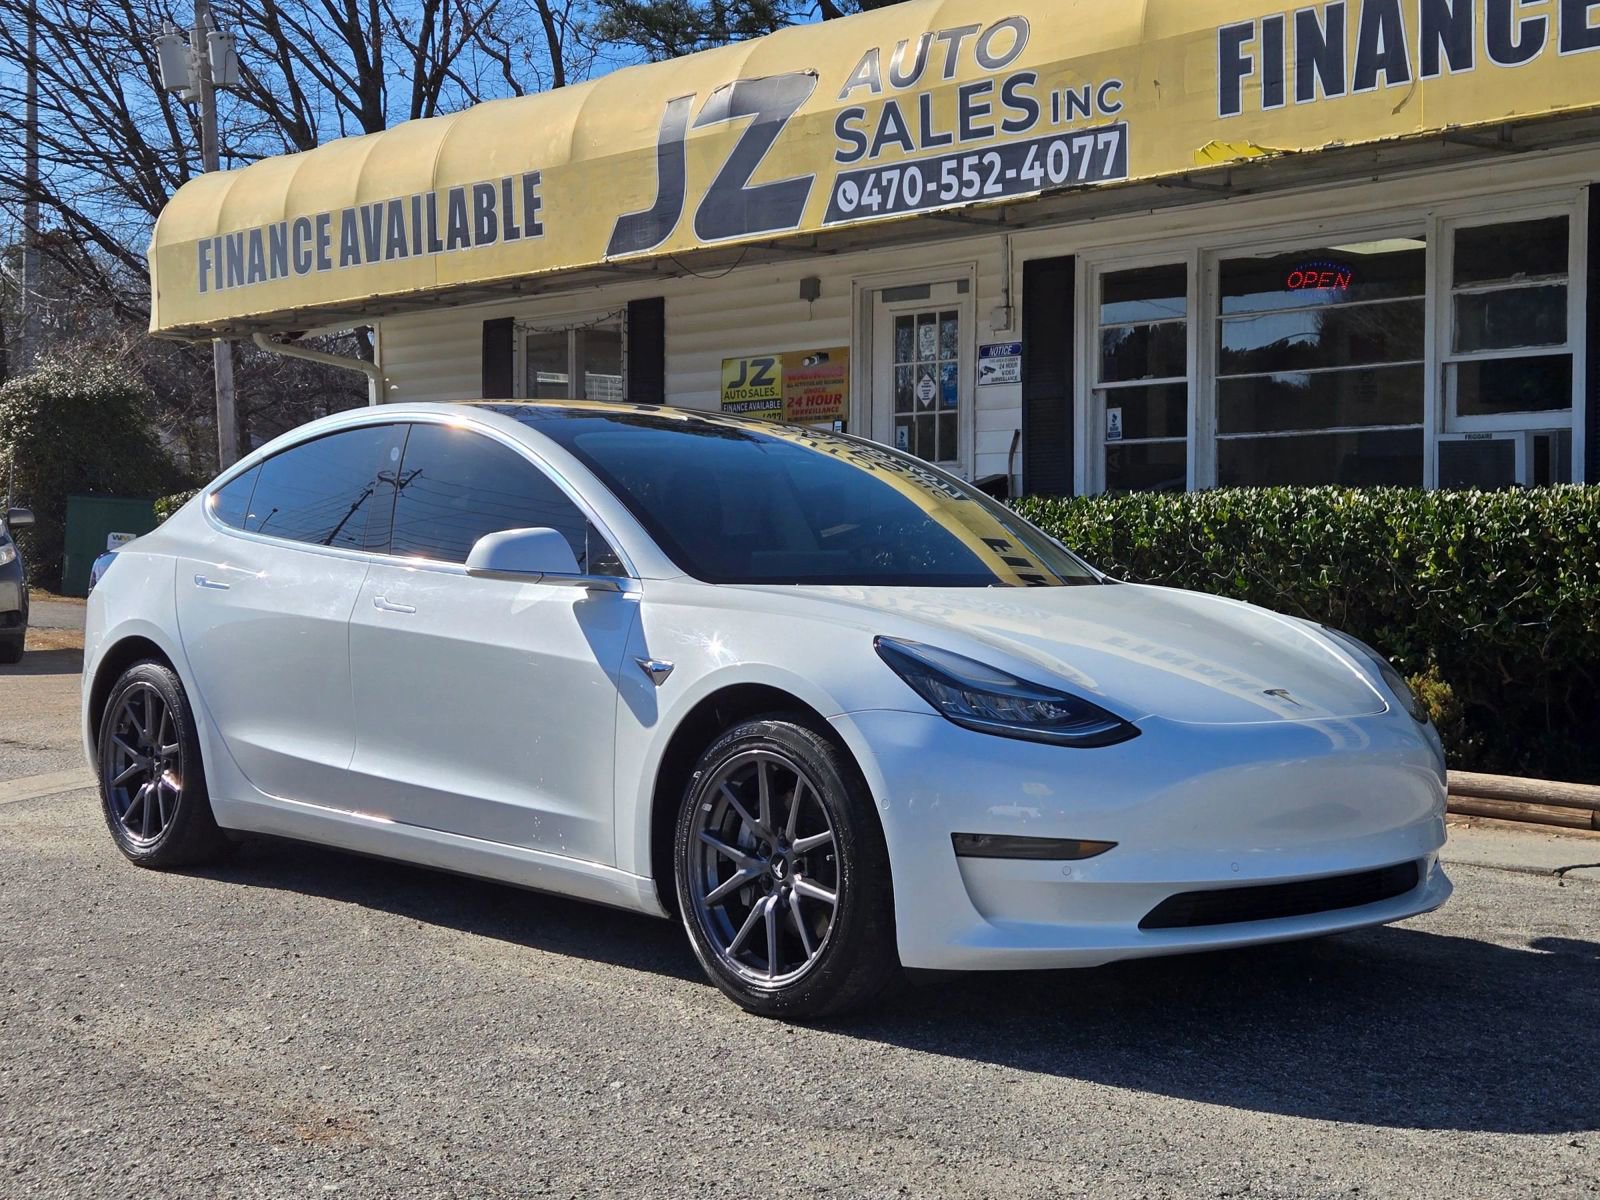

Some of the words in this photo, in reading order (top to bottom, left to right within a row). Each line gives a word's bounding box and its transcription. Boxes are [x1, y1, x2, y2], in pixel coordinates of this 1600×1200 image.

[837, 16, 1030, 101] AUTO
[833, 71, 1040, 163] SALES
[1050, 79, 1124, 124] INC
[603, 70, 818, 262] JZ
[860, 130, 1120, 212] 470-552-4077
[198, 212, 333, 294] FINANCE
[339, 170, 545, 268] AVAILABLE
[1287, 271, 1352, 290] OPEN
[990, 345, 1013, 356] NOTICE
[727, 358, 776, 388] JZ
[724, 389, 747, 400] AUTO
[748, 387, 775, 398] SALES
[787, 396, 803, 408] 24
[806, 393, 843, 407] HOUR
[723, 402, 748, 412] FINANCE
[748, 400, 781, 411] AVAILABLE
[792, 406, 840, 416] SURVEILLANCE
